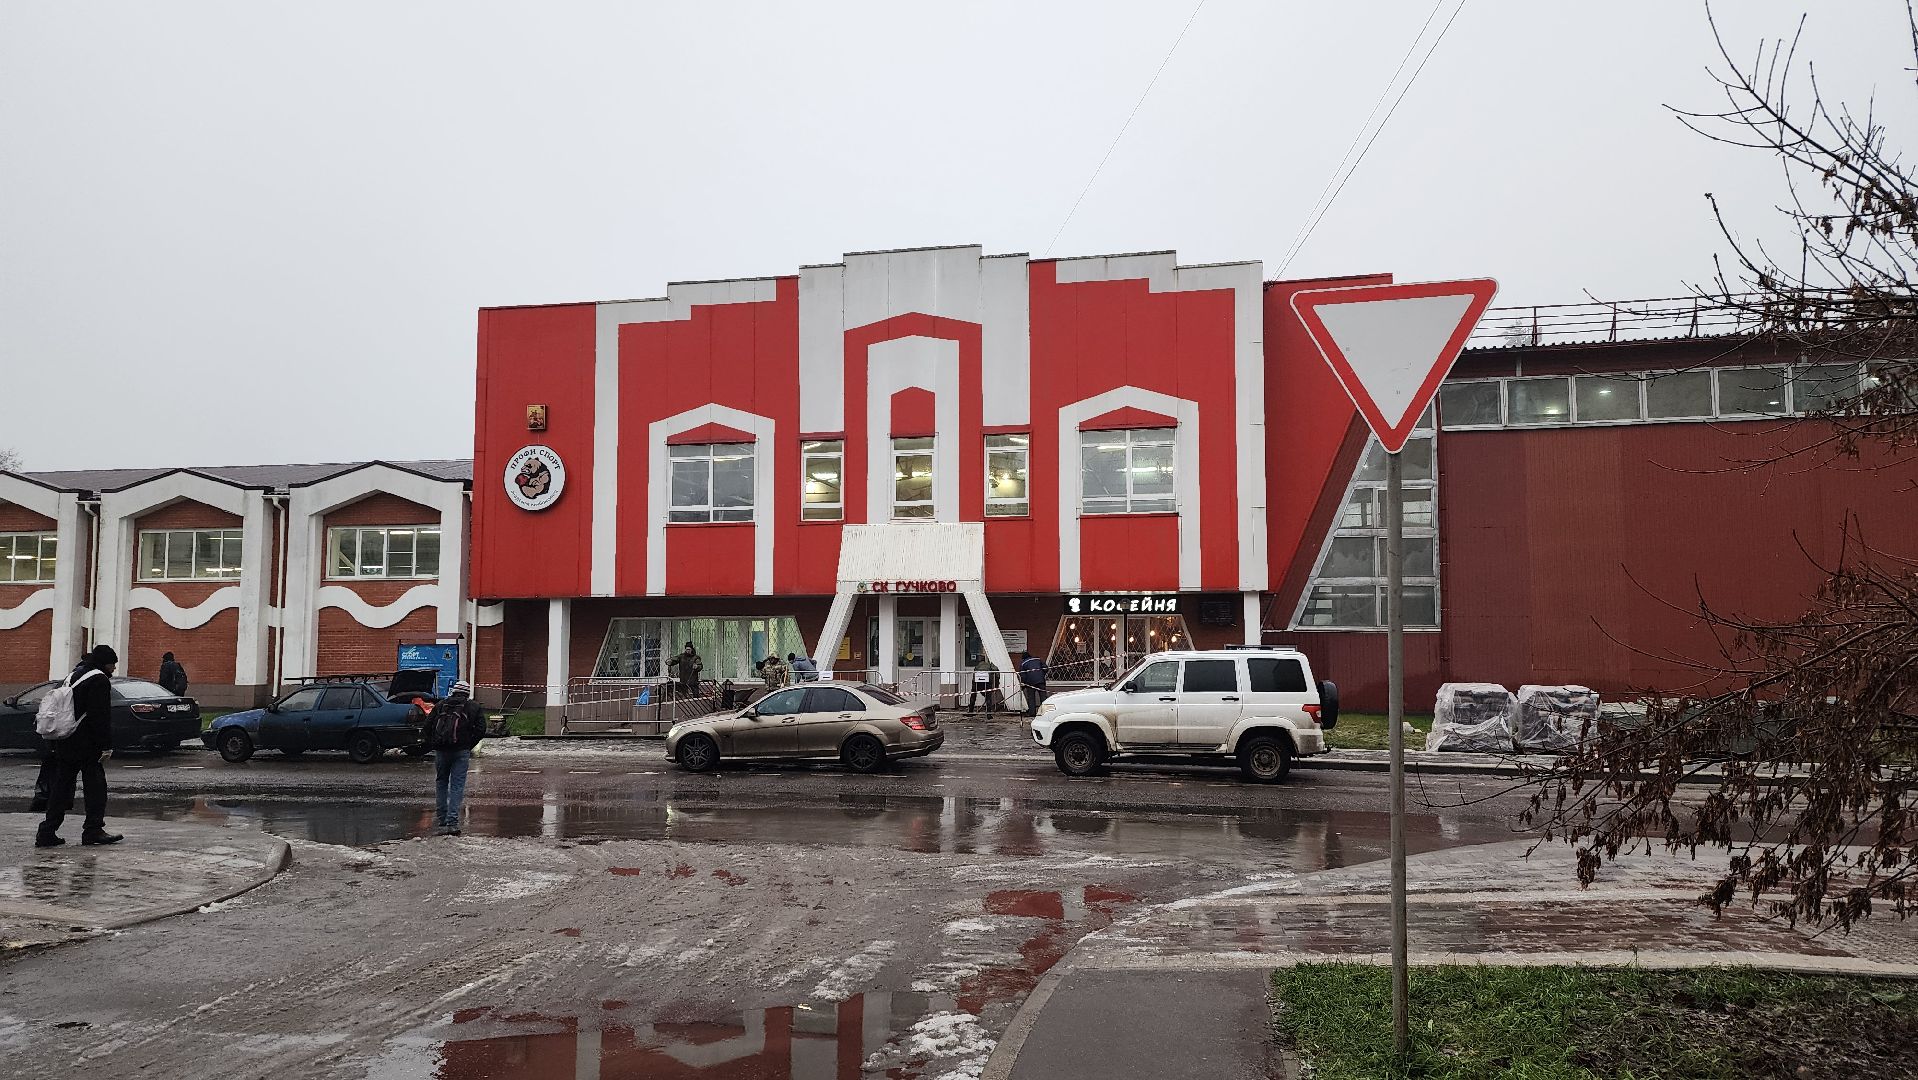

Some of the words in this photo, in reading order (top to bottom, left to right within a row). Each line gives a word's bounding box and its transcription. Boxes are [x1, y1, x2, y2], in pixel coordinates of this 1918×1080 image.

[540, 450, 560, 469] СПОРТ
[873, 581, 888, 592] СК
[896, 581, 956, 592] ГУЧКОВО
